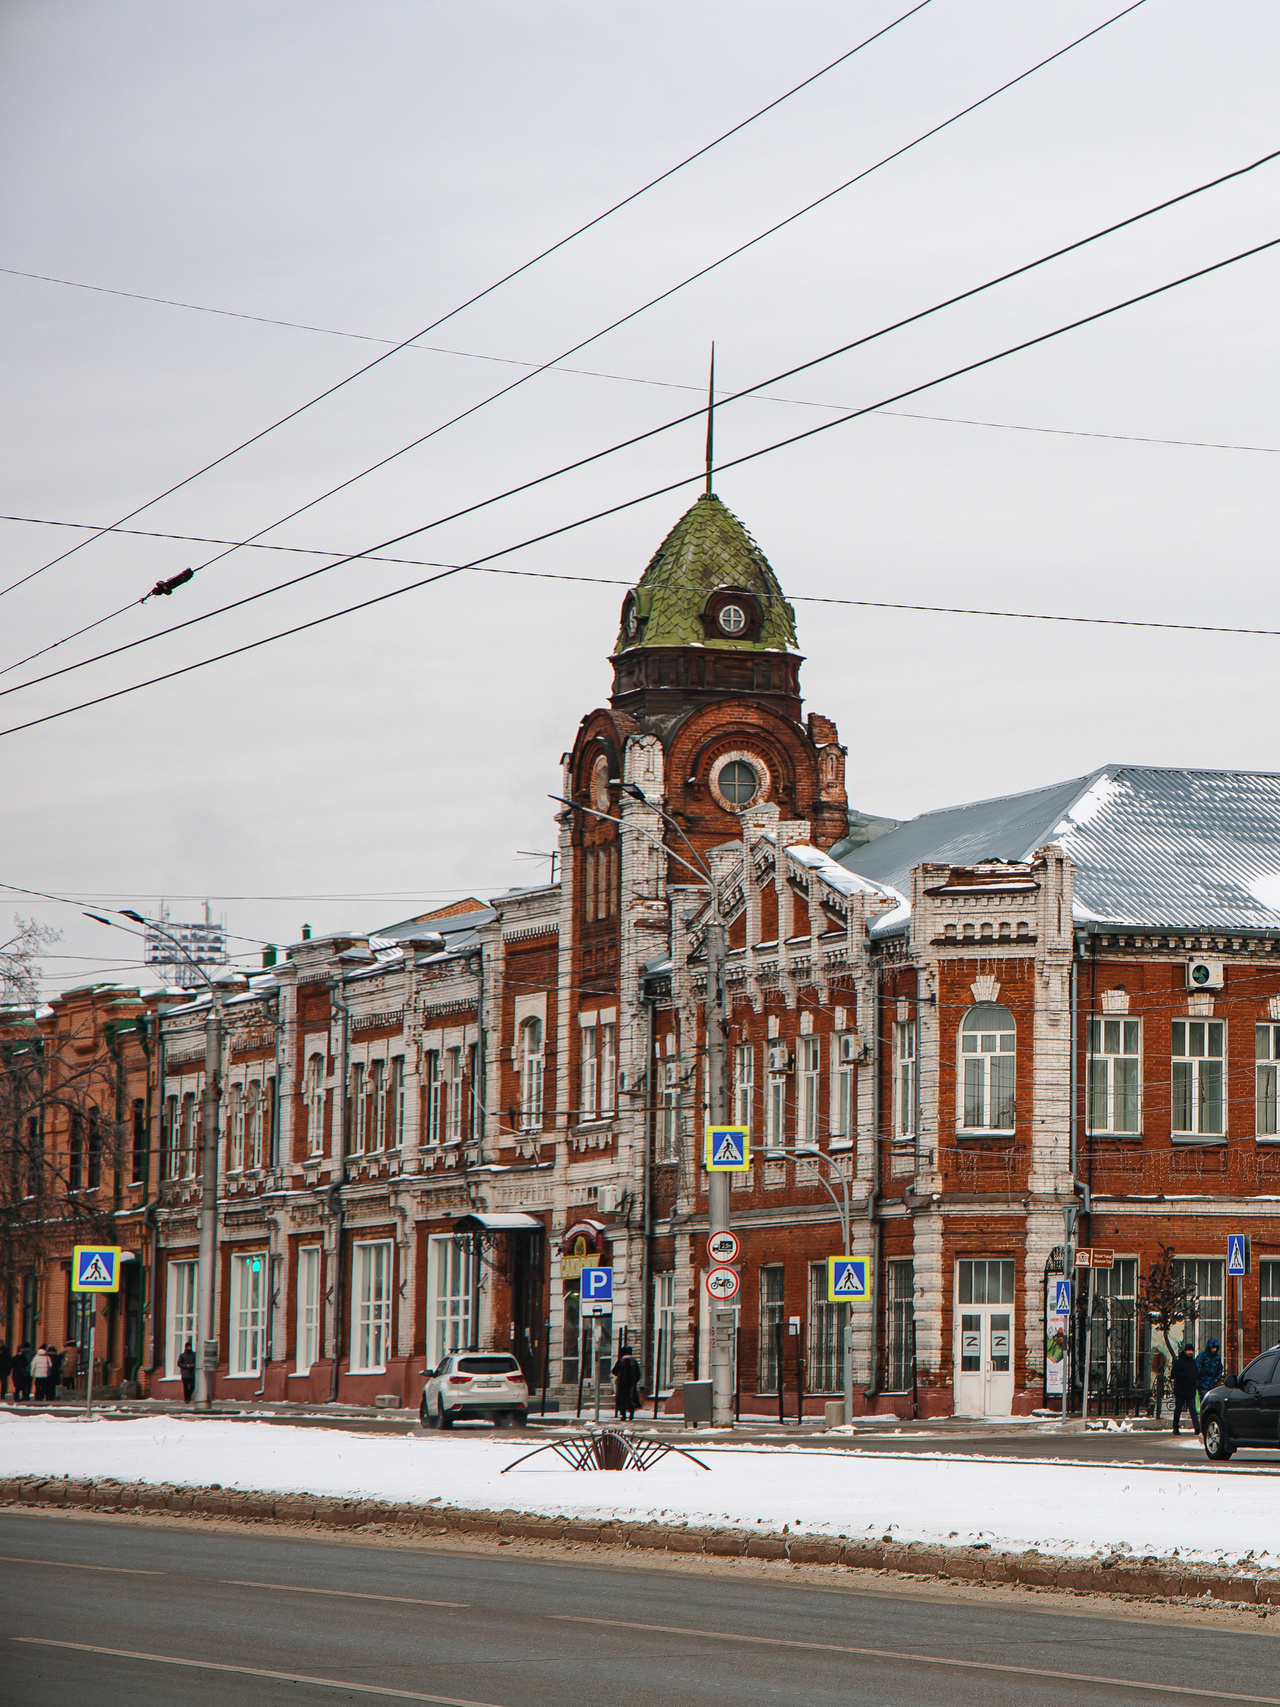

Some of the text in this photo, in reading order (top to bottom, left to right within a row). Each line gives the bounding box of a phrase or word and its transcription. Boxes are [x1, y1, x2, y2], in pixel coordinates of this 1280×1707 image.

[590, 1271, 608, 1296] P
[965, 1336, 978, 1347] Z
[993, 1336, 1007, 1347] Z
